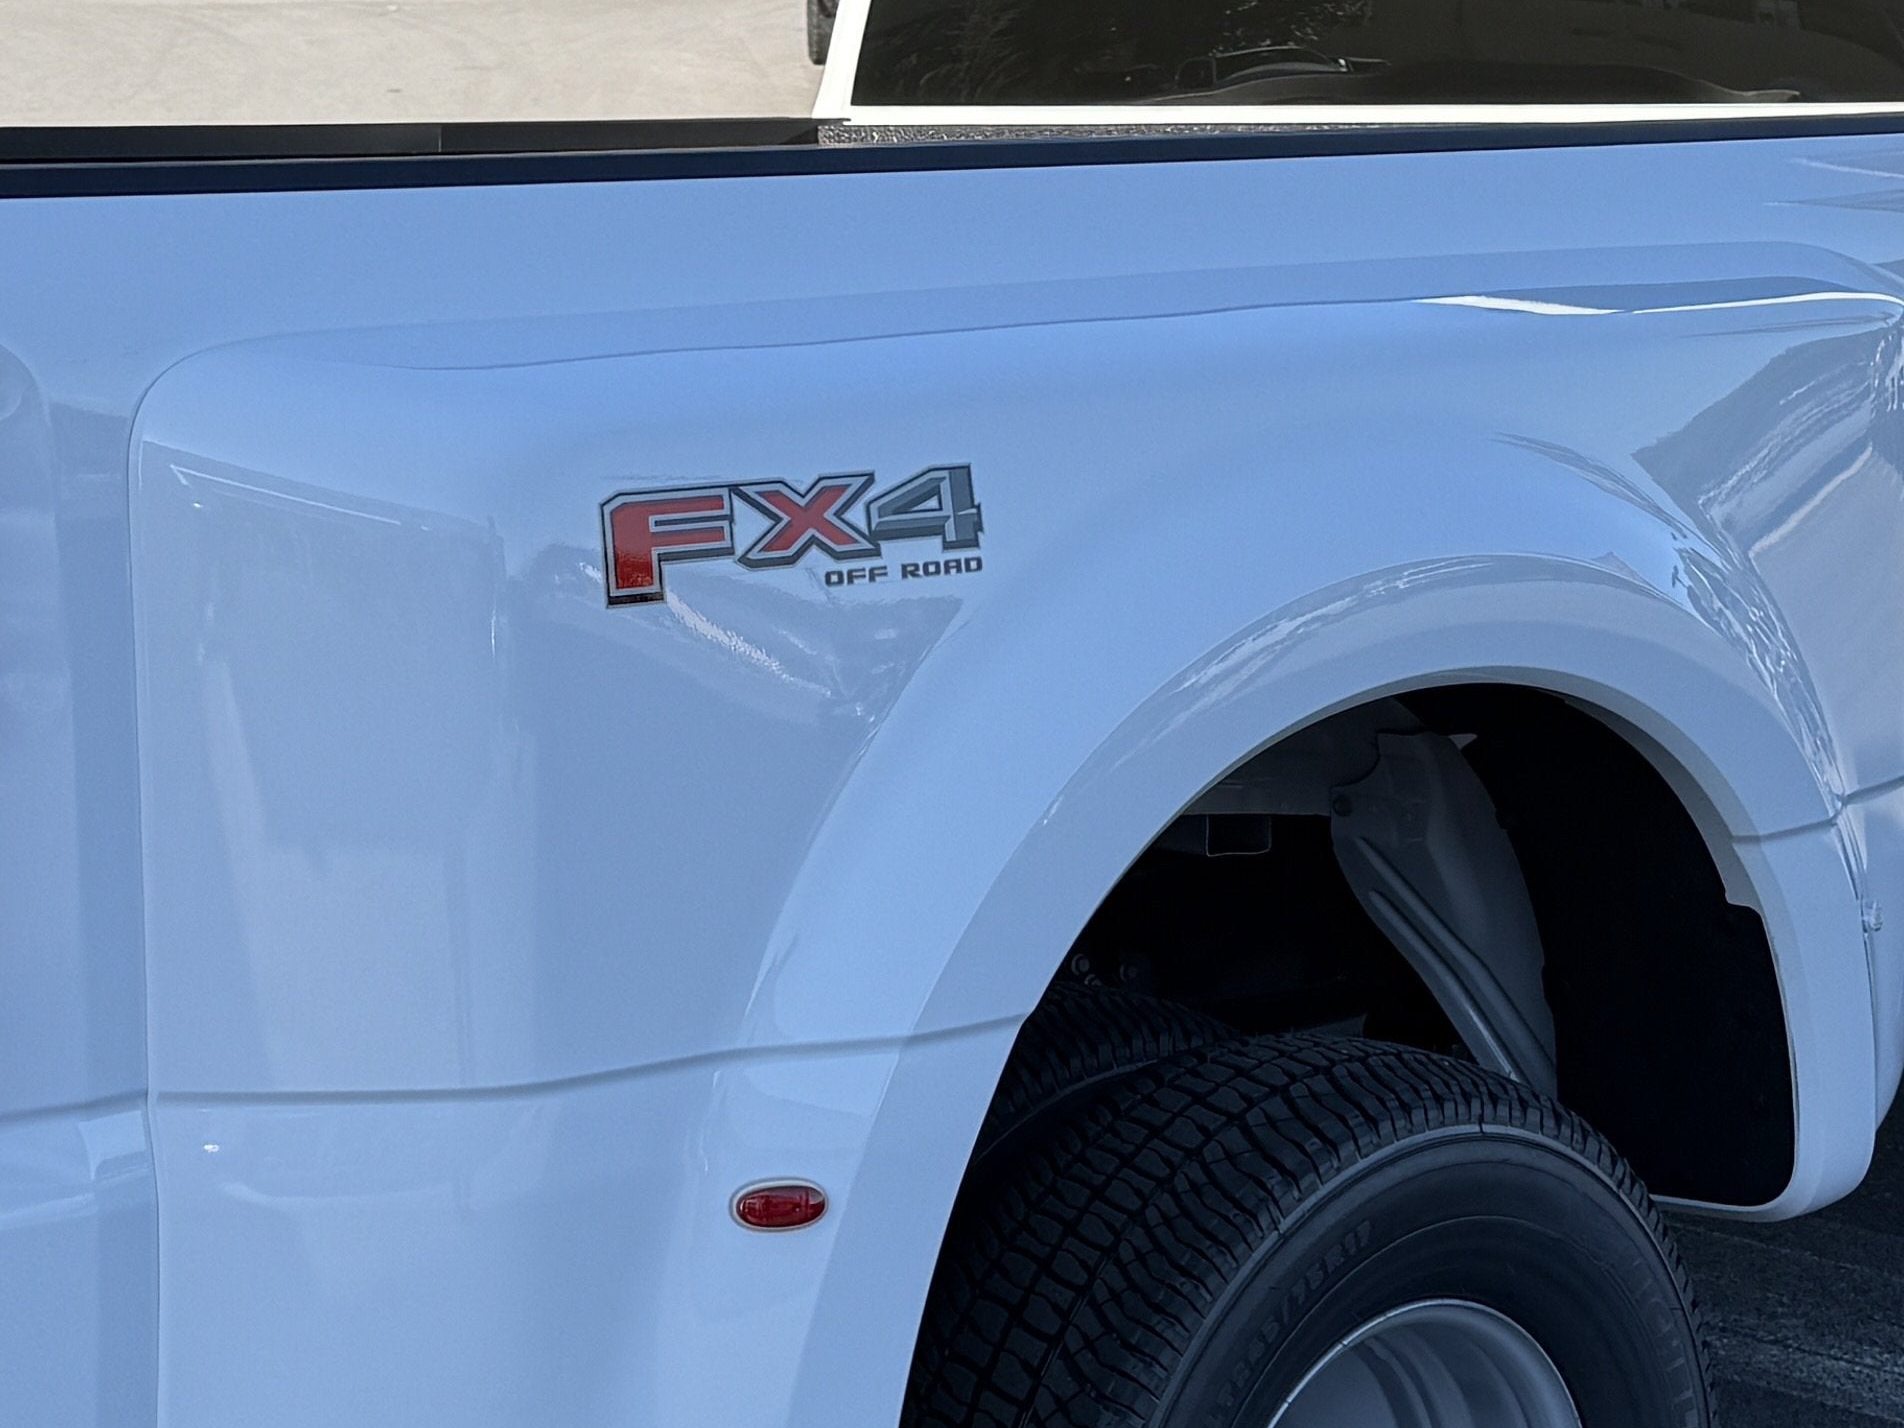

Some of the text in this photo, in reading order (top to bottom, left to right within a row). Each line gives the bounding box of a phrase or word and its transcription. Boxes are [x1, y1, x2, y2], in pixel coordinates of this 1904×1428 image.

[600, 462, 984, 609] FX4
[825, 557, 983, 587] OFF ROAD
